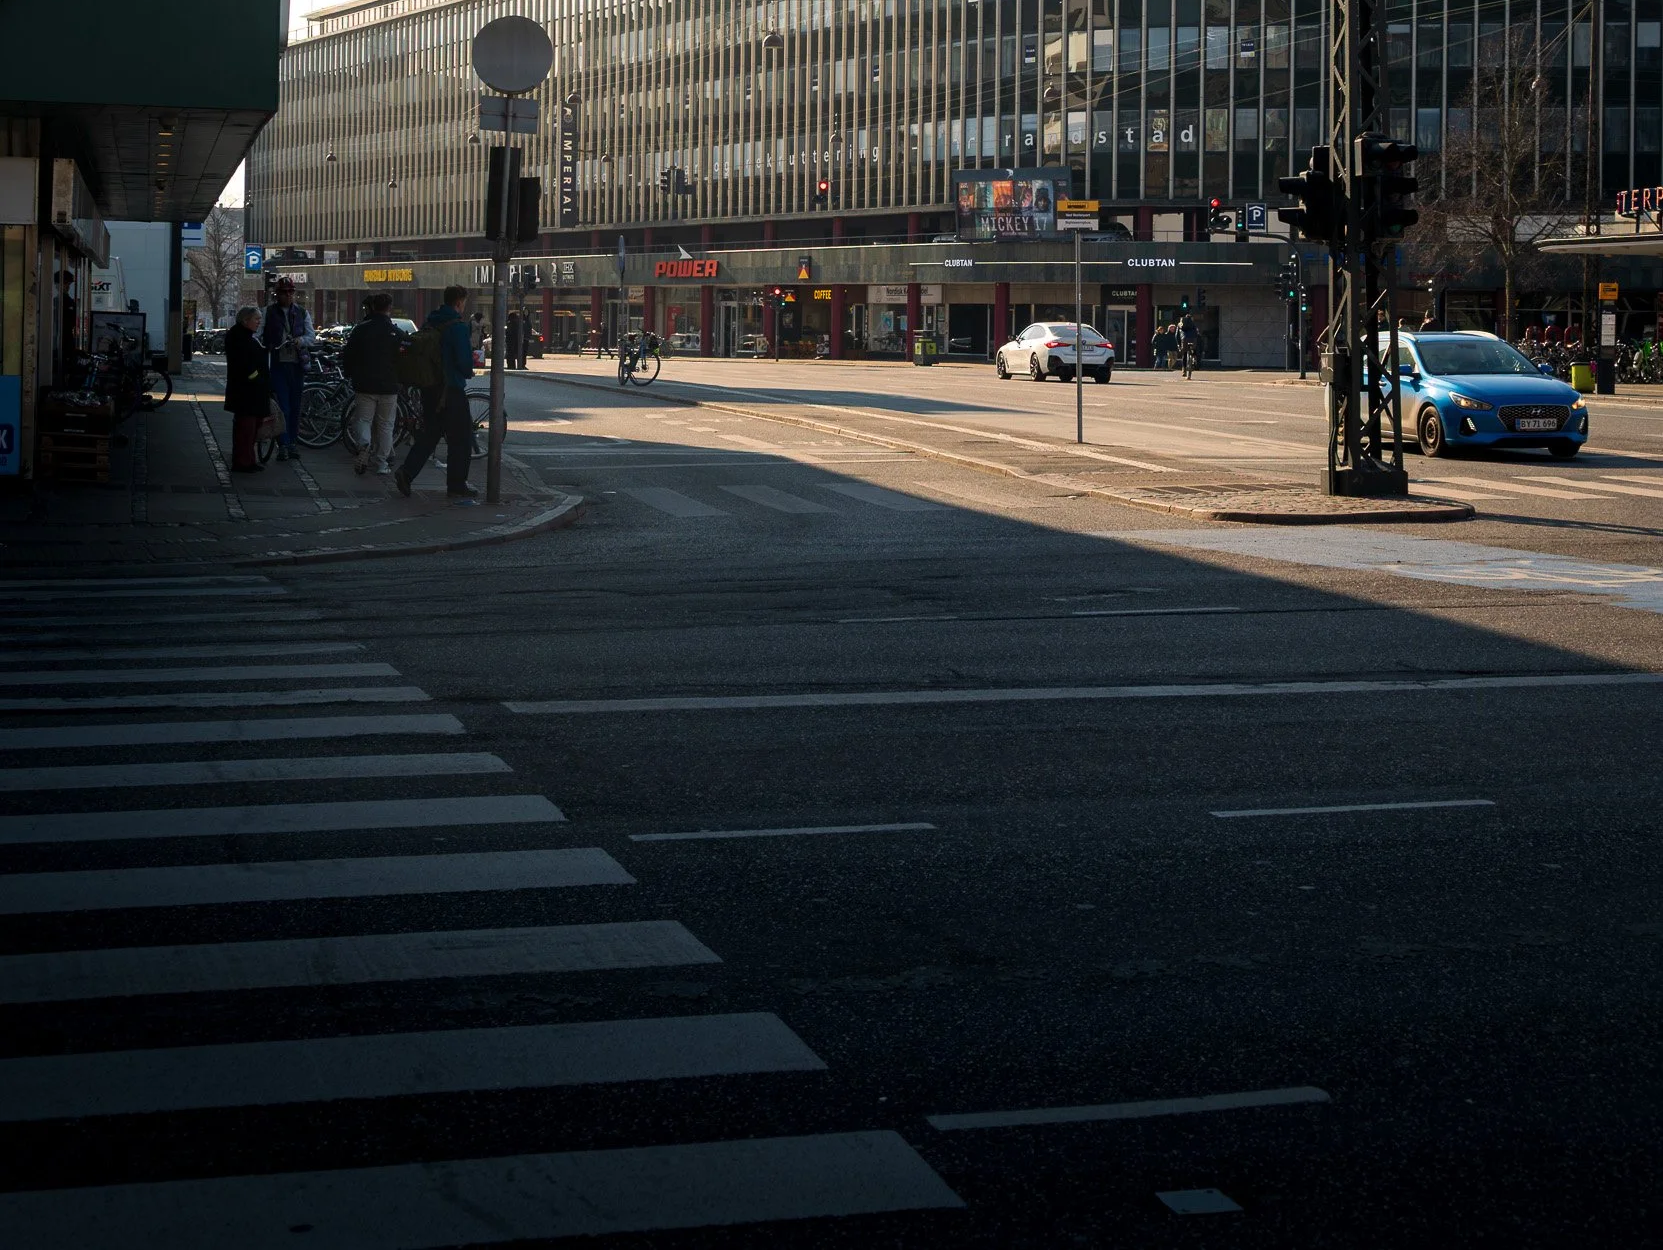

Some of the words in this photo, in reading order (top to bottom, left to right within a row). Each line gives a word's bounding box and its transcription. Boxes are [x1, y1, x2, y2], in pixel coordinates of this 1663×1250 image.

[1005, 125, 1194, 147] randstad
[562, 132, 572, 214] IMPERIAL
[1253, 209, 1261, 221] P
[980, 216, 1029, 232] MICKEY
[1033, 216, 1048, 231] 17
[249, 255, 260, 267] P
[944, 258, 973, 268] CLUBTAN
[1127, 258, 1176, 268] CLUBTAN
[655, 259, 719, 278] POWER
[813, 289, 832, 300] COFFEE
